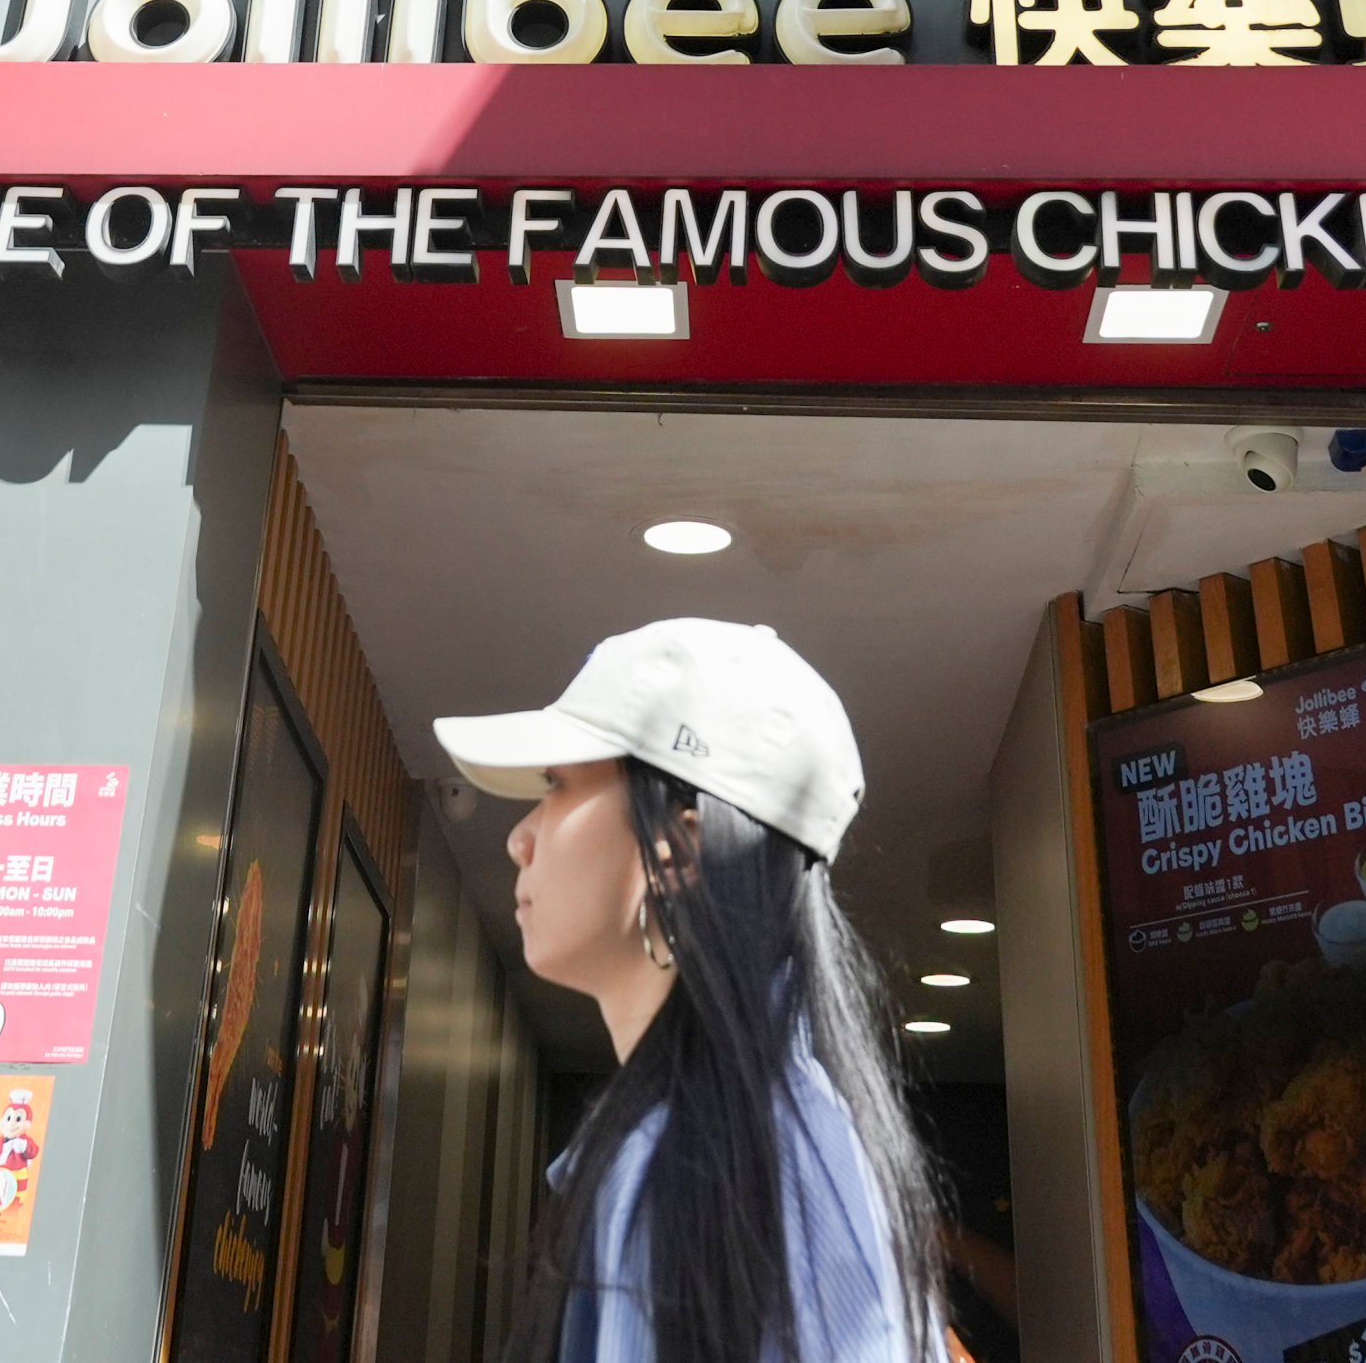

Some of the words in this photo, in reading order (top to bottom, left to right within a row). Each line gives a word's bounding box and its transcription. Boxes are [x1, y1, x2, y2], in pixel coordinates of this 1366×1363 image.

[85, 186, 240, 272] OF
[275, 187, 481, 276] THE
[509, 188, 987, 276] FAMOUS
[1295, 687, 1357, 715] Jollibee
[1297, 703, 1361, 740] 快樂蜂
[1120, 750, 1176, 788] NEW
[1137, 750, 1317, 844] 酥脆雞塊
[17, 812, 66, 827] Hours
[1141, 837, 1222, 874] Crispy
[1228, 813, 1338, 855] Chicken
[42, 888, 77, 902] SUN
